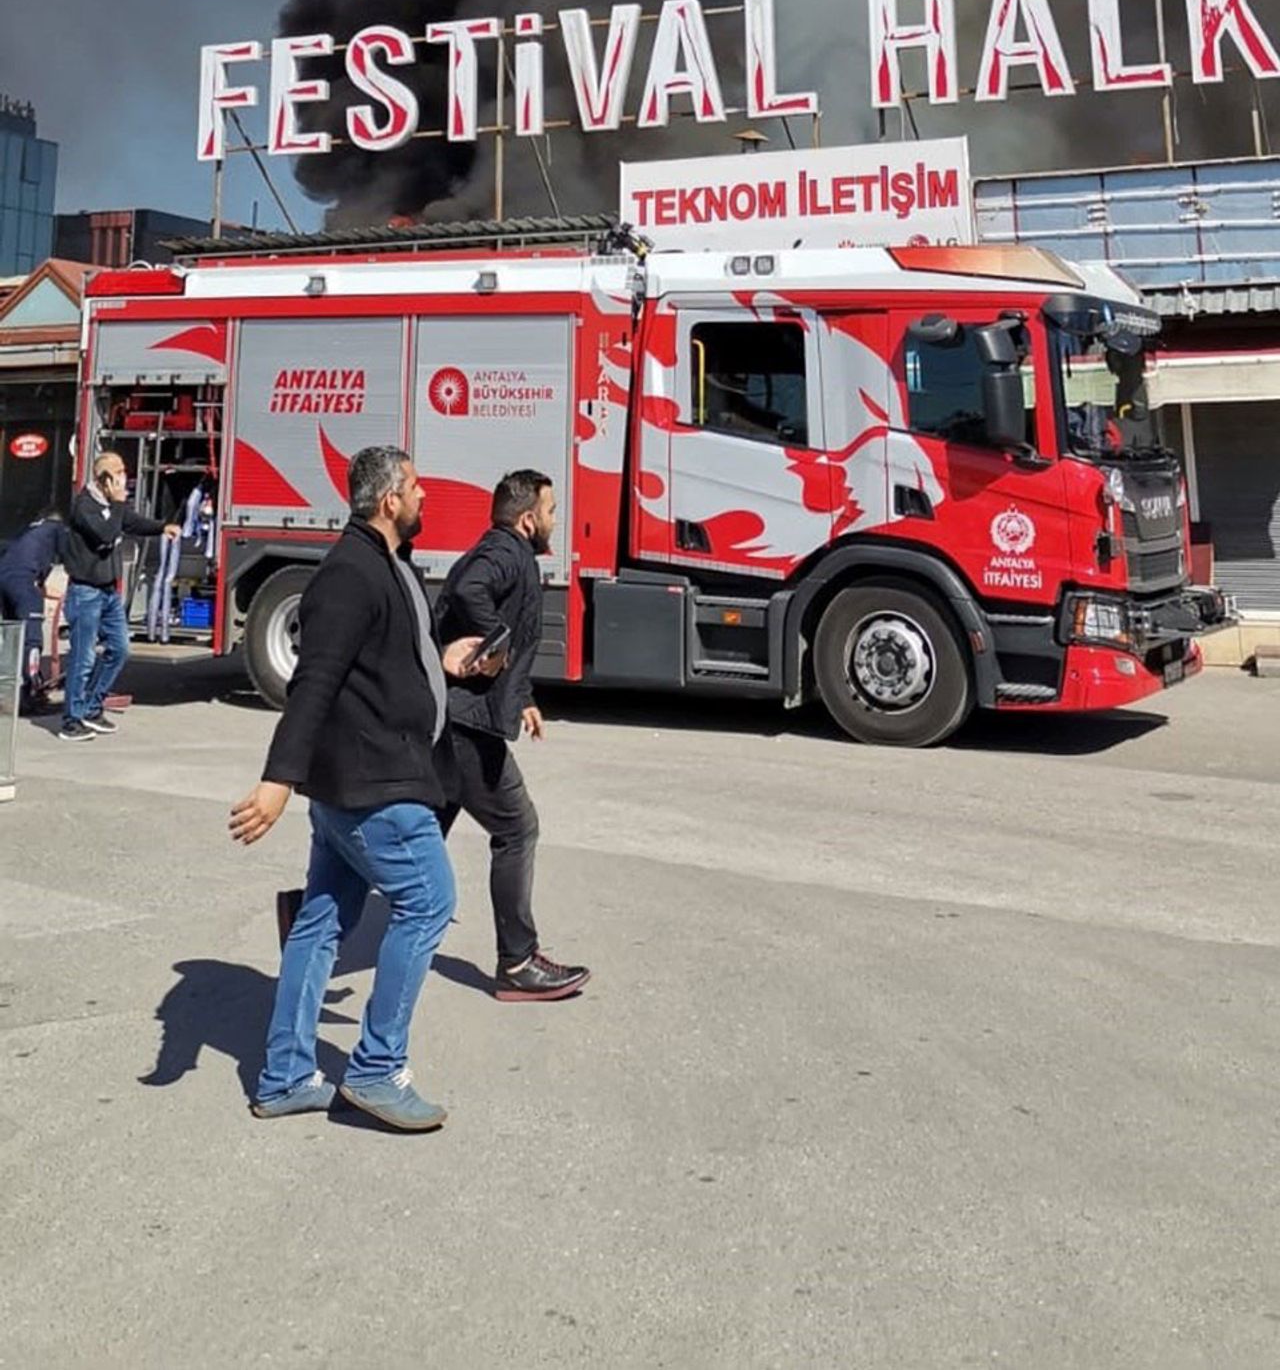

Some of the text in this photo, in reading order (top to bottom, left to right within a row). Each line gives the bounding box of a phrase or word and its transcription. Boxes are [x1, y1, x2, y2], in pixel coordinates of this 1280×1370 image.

[632, 162, 959, 227] TEKNOM İLETİŞİM
[275, 370, 365, 389] ANTALYA
[473, 371, 527, 382] ANTALYA
[472, 403, 537, 417] BELEDİYESİ
[990, 556, 1035, 569] ANTALYA
